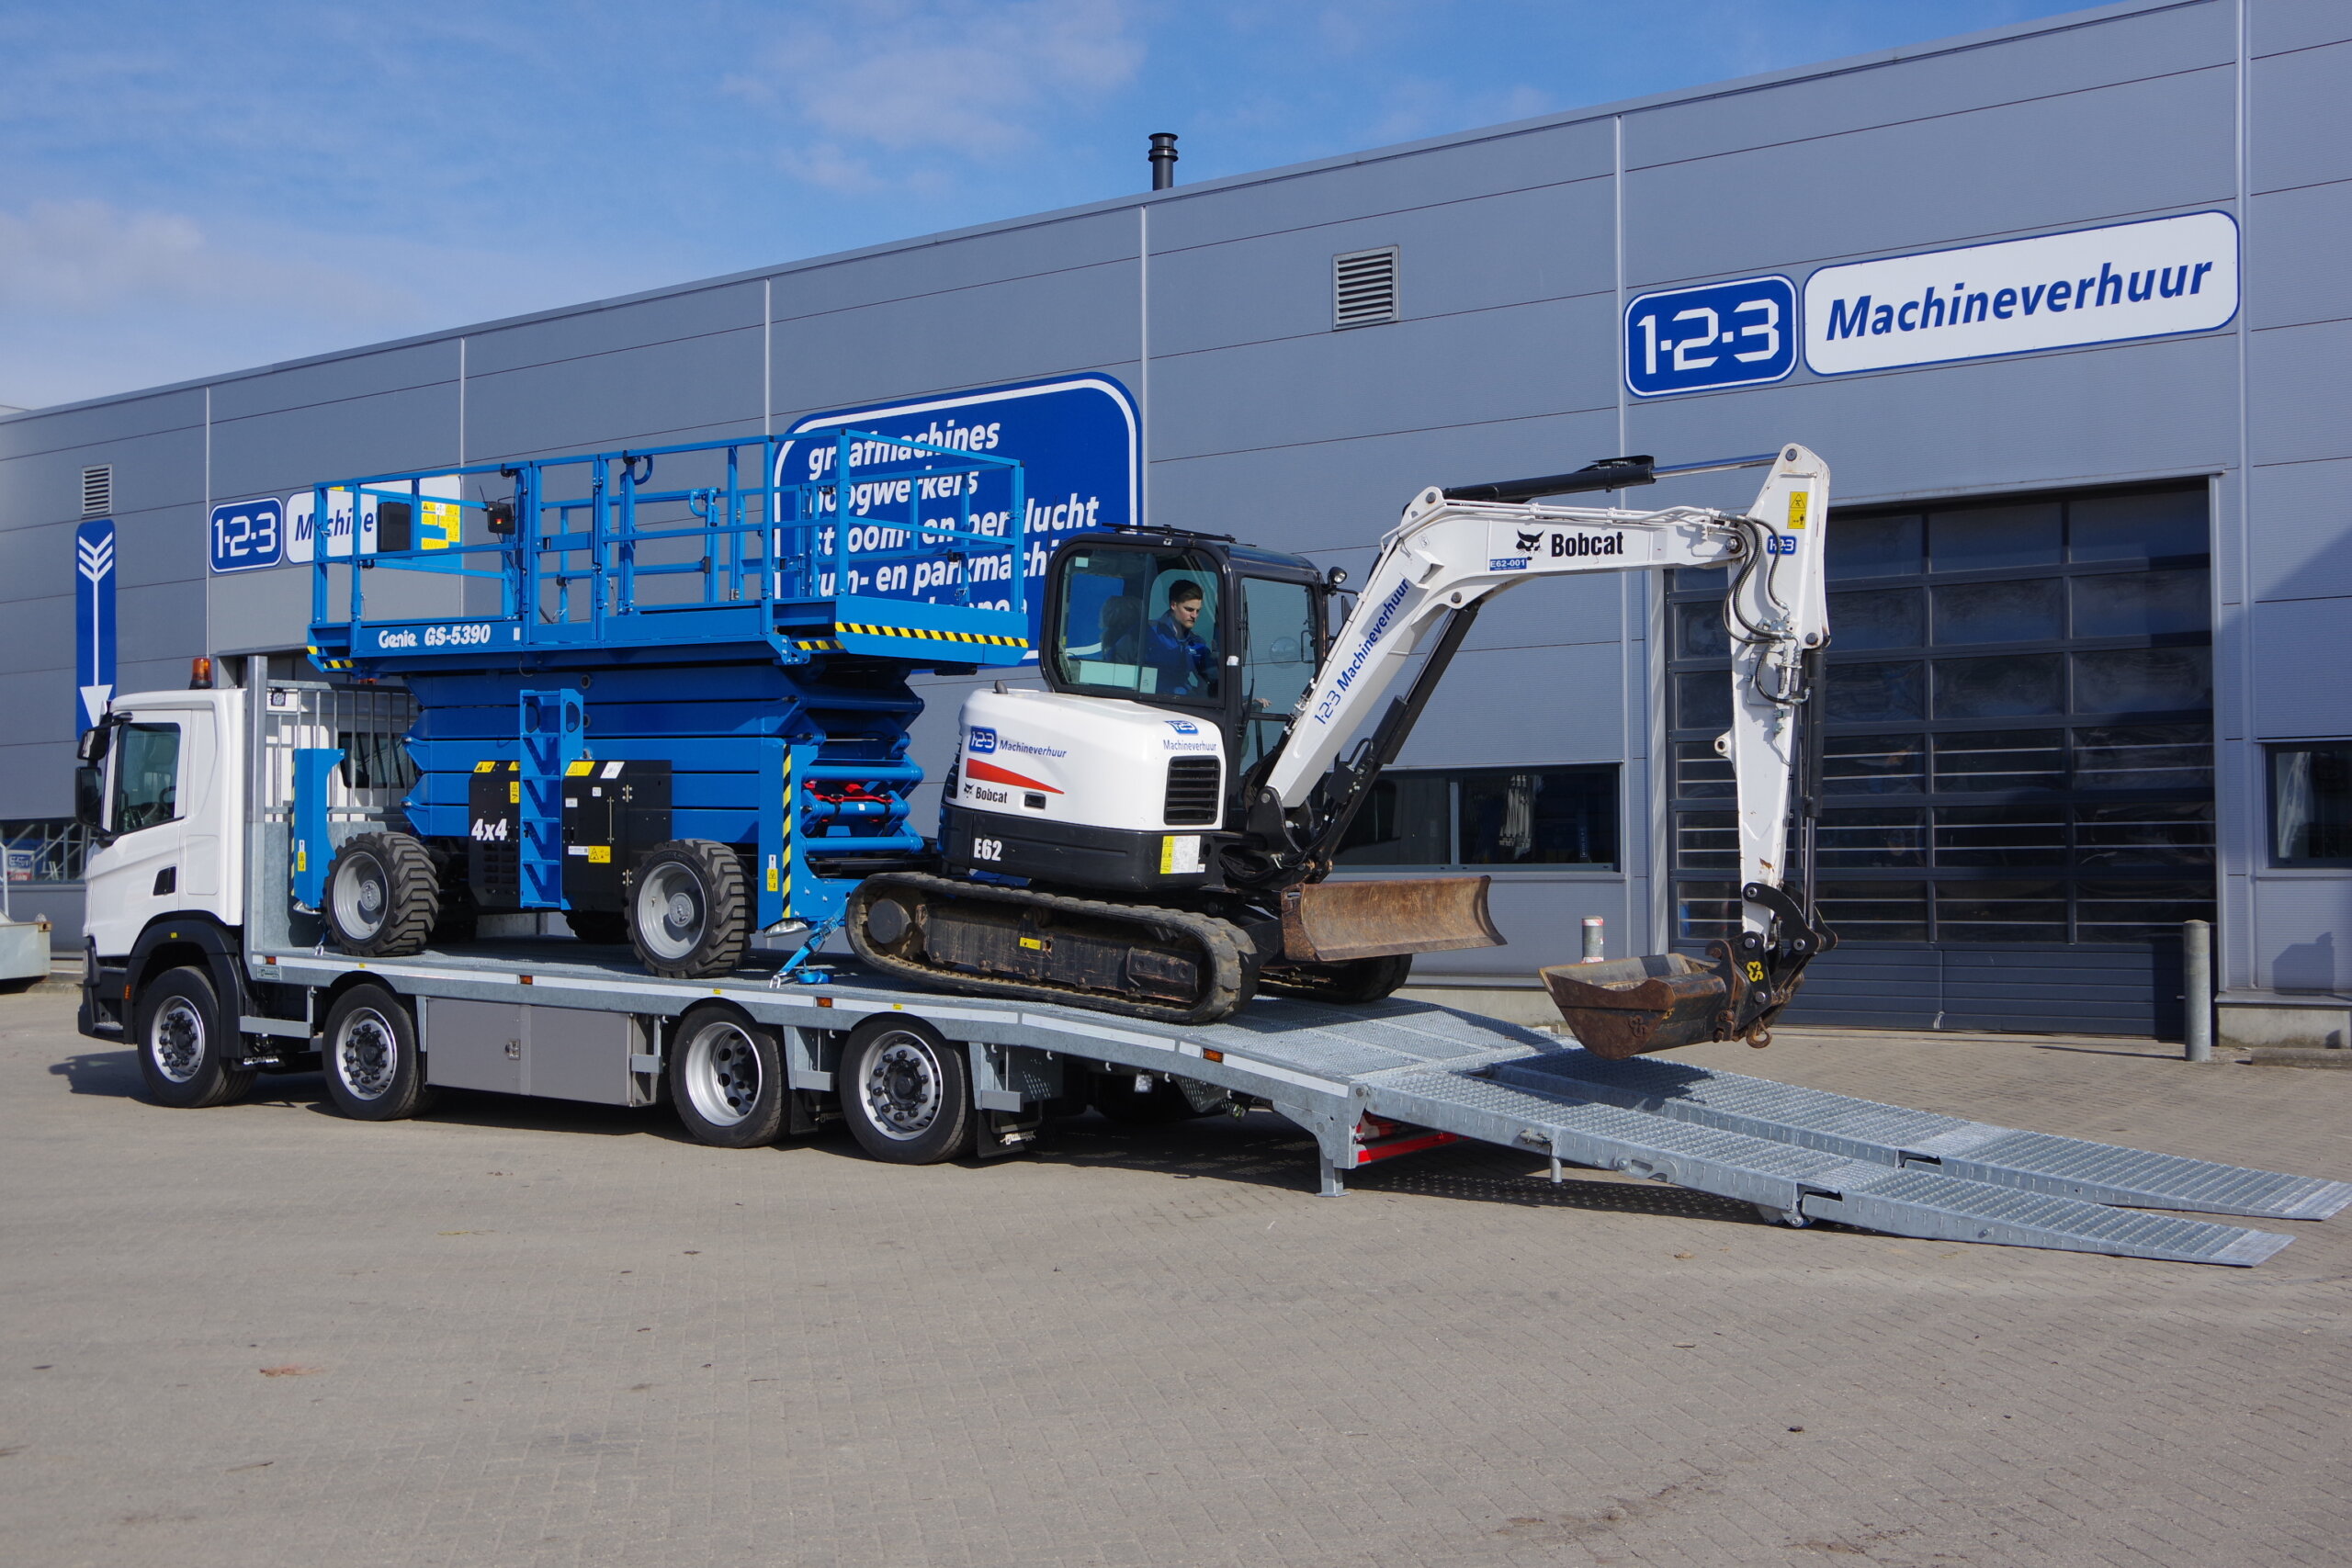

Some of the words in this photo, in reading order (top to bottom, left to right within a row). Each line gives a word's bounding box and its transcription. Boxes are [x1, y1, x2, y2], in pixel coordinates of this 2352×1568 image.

[1825, 261, 2213, 341] Machineverhuur
[1551, 530, 1624, 558] Bobcat
[1490, 558, 1526, 569] E62-001
[876, 563, 908, 592] en
[379, 630, 418, 649] Genie
[424, 624, 491, 646] GS-5390
[1336, 578, 1409, 692] Machineverhuur
[999, 739, 1067, 758] Machineverhuur
[1162, 739, 1217, 750] Machineverhuur
[976, 786, 1008, 804] Bobcat
[471, 818, 508, 840] 4x4
[973, 838, 1002, 862] E62
